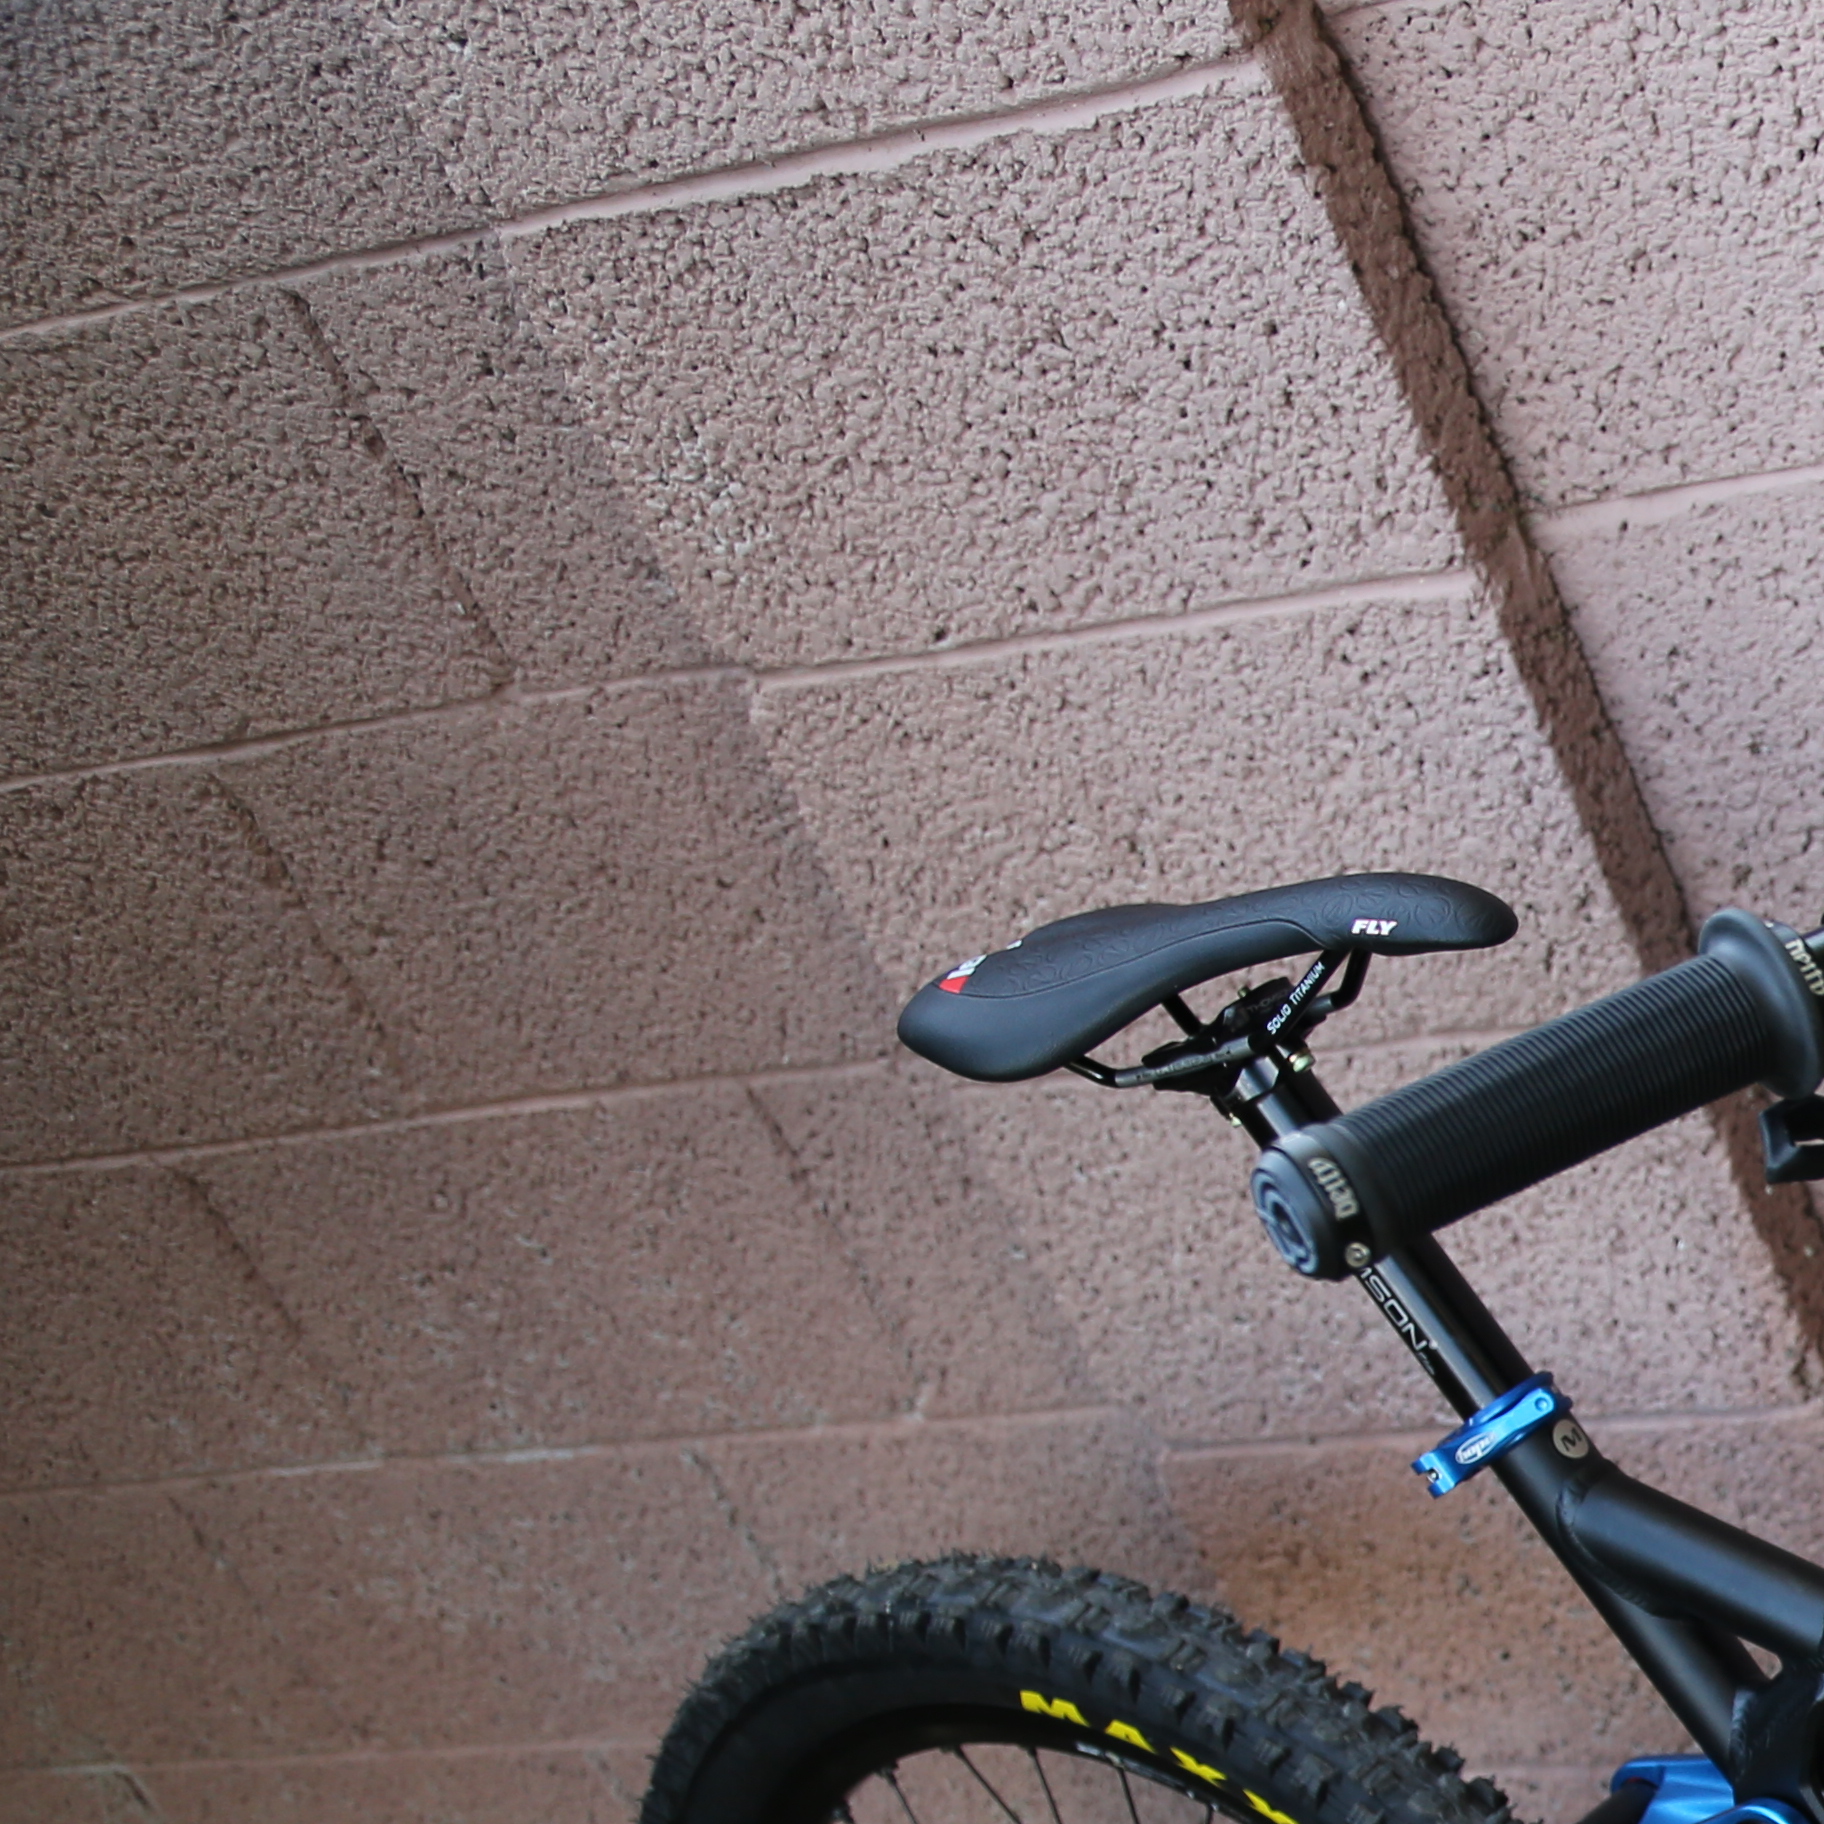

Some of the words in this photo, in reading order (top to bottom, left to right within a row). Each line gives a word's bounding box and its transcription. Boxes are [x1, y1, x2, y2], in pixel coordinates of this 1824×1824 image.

[1351, 918, 1398, 937] FLY
[1288, 960, 1326, 1006] TITANIUM
[1561, 1427, 1582, 1452] M
